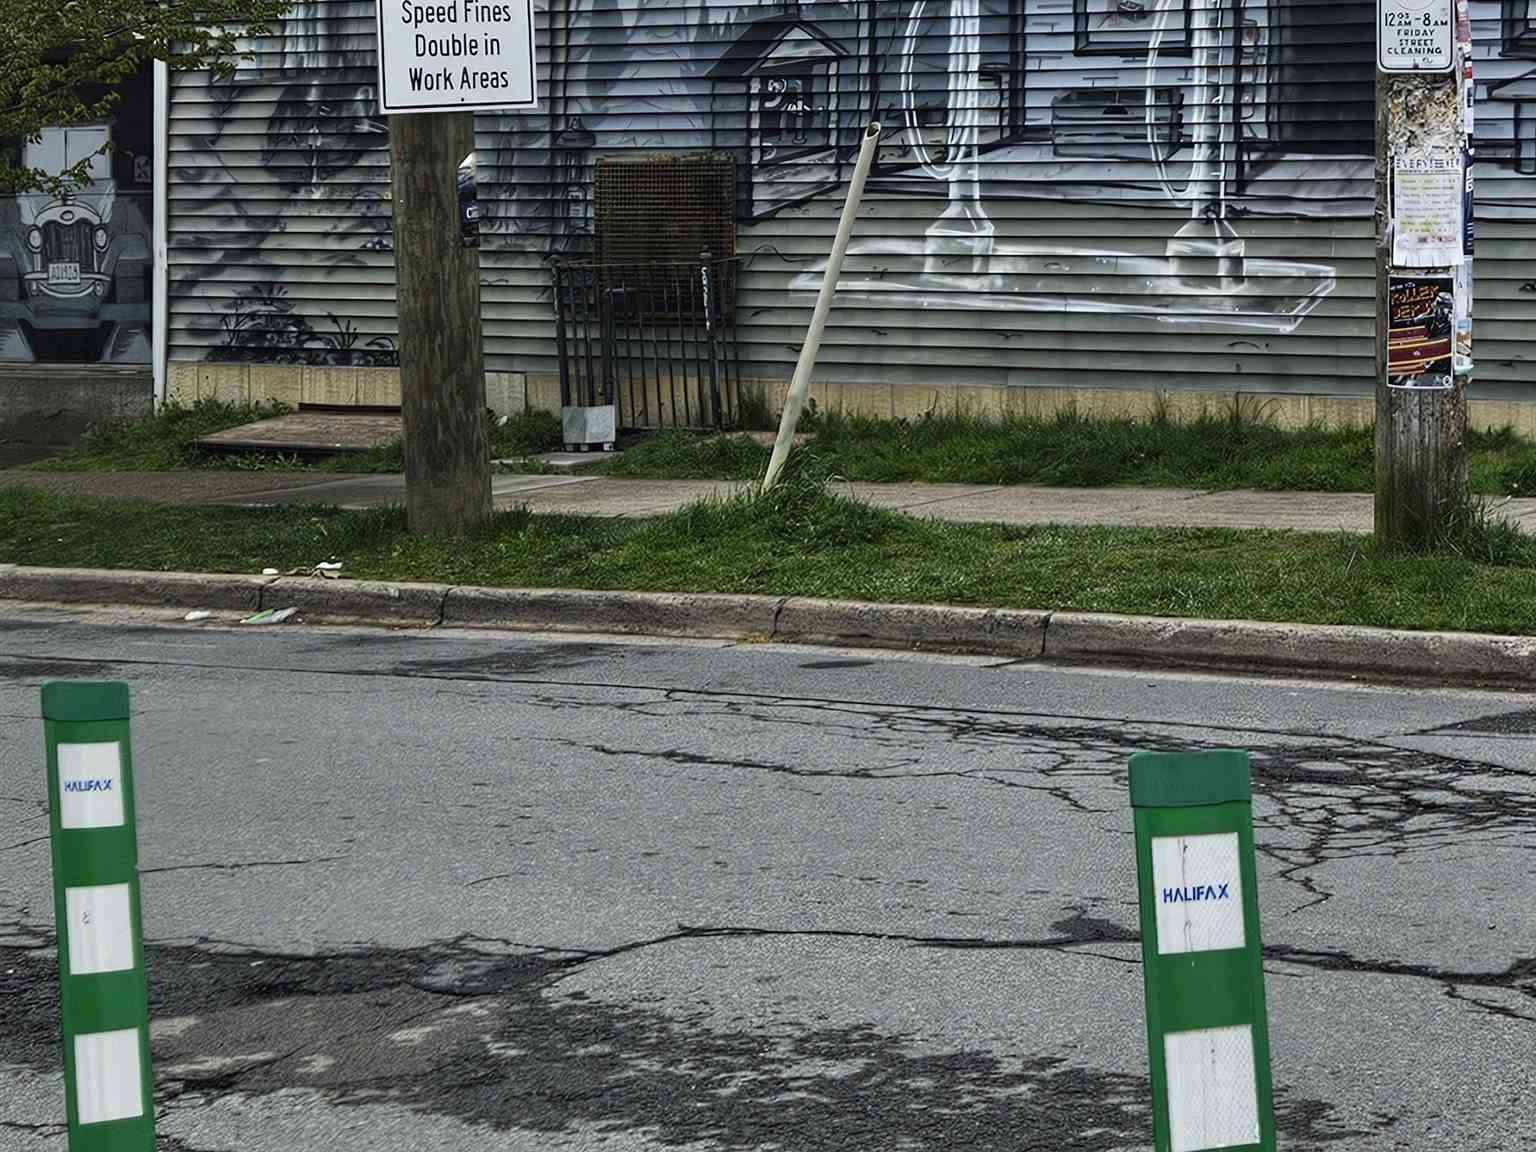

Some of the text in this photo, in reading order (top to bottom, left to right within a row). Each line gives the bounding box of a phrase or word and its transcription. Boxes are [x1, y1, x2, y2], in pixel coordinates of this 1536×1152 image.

[402, 0, 511, 29] Speed Fines
[1385, 13, 1395, 26] 12
[1423, 13, 1431, 26] 8
[416, 33, 500, 57] Double in
[409, 67, 508, 91] Work Areas
[64, 778, 113, 792] HALIFAX
[1163, 883, 1230, 904] HALIFAX
